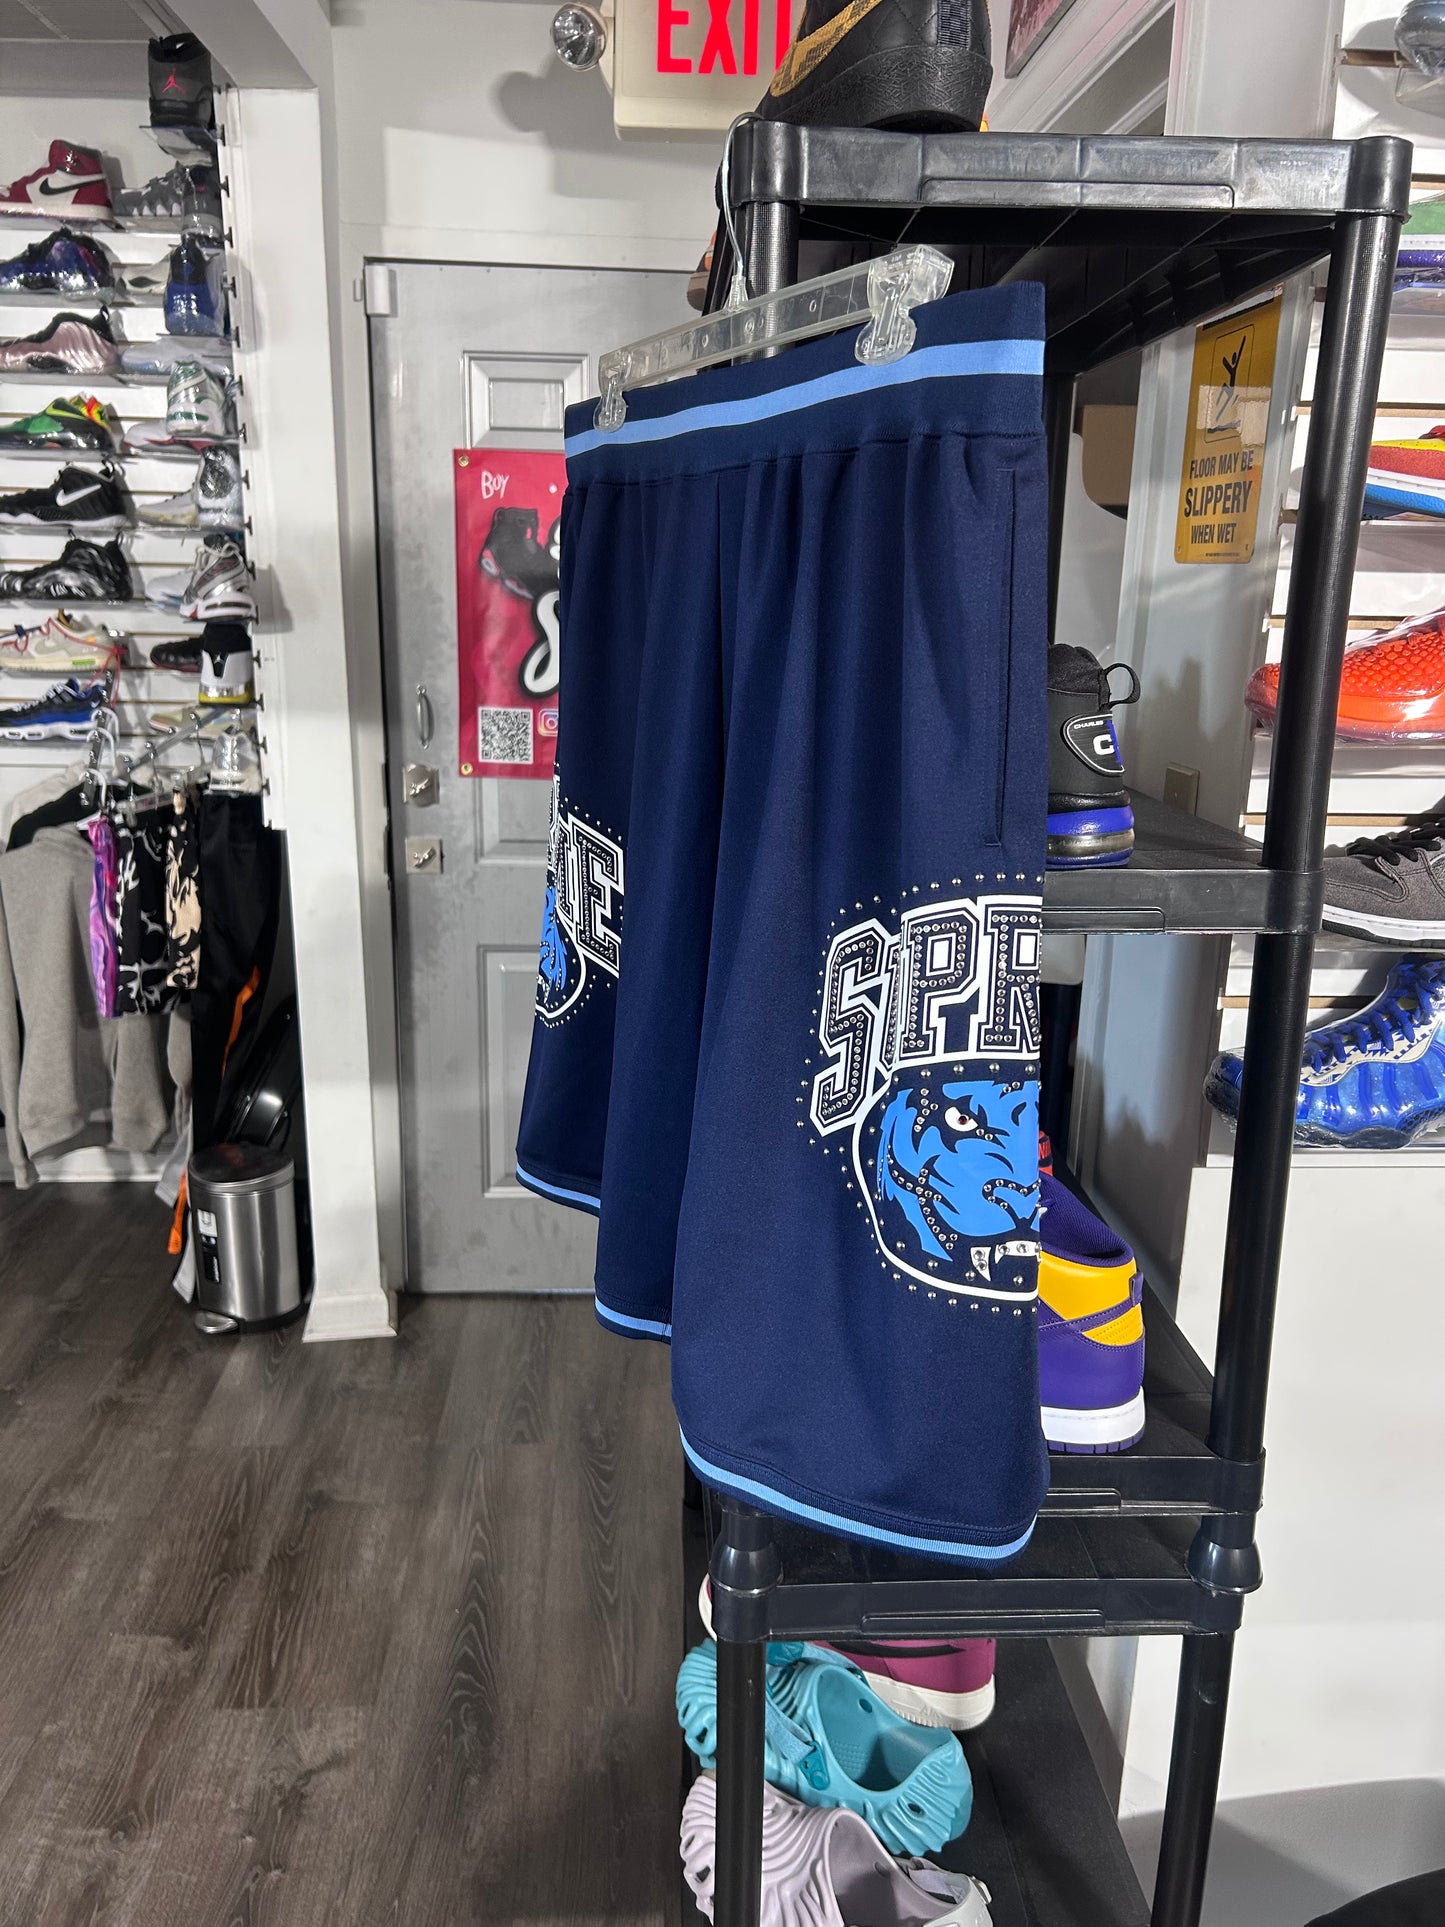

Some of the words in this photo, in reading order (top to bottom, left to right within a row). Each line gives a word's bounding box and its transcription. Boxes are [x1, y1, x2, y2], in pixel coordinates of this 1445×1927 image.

[1190, 456, 1216, 480] FLOOR
[1218, 452, 1239, 475] MAY
[1240, 450, 1254, 472] BE
[1184, 480, 1252, 518] SLIPPERY
[1191, 524, 1216, 544] WHEN
[1217, 523, 1237, 544] WET
